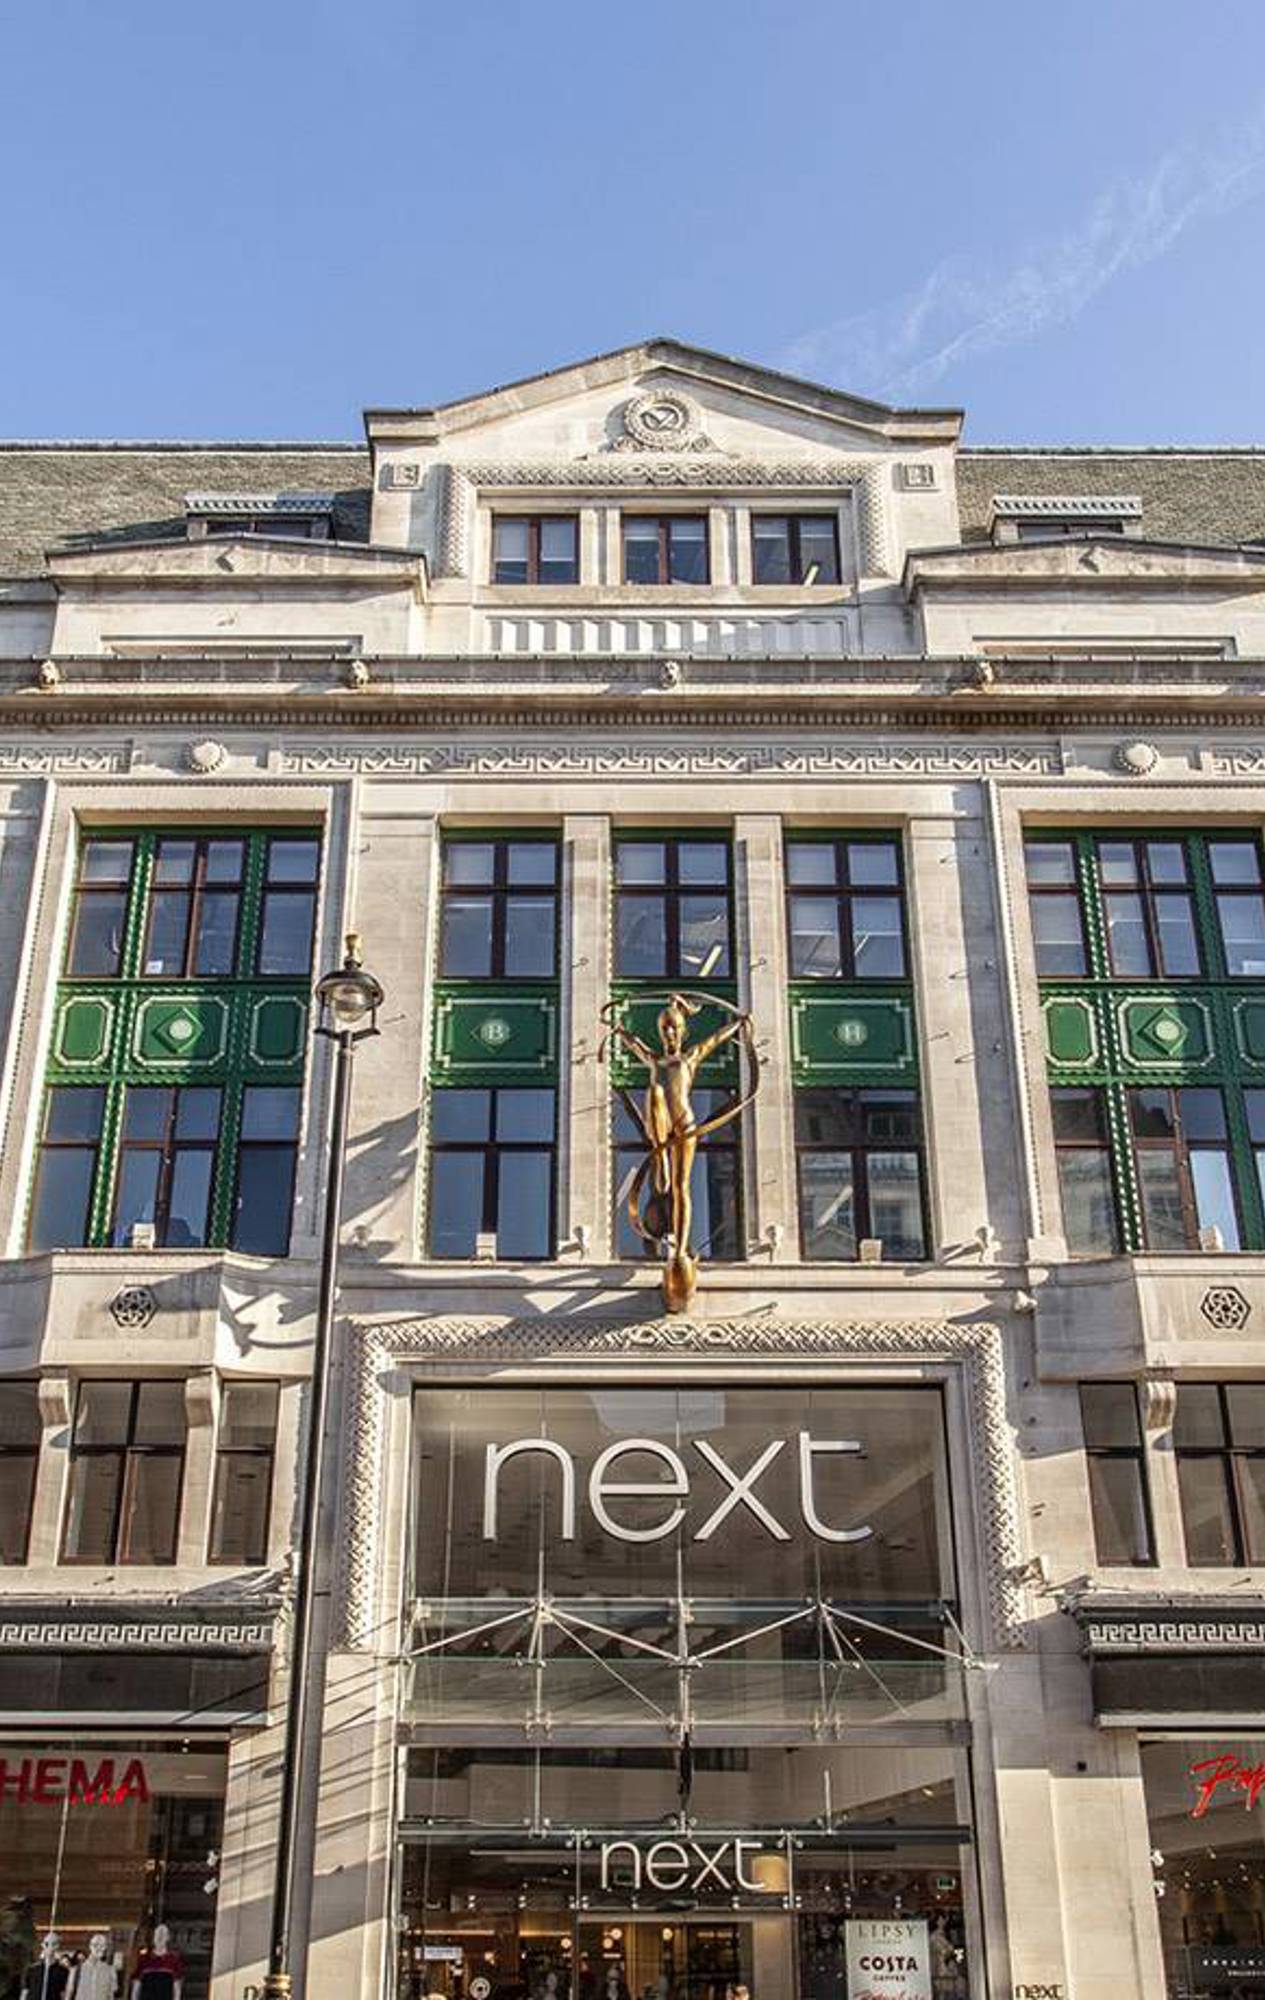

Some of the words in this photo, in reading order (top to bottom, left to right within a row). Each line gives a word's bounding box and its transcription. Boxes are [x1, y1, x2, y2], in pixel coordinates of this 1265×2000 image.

[483, 1430, 873, 1543] next
[0, 1757, 149, 1804] HEMA
[601, 1838, 766, 1890] next
[859, 1924, 915, 1938] LIPSY
[859, 1955, 919, 1973] COSTA
[1015, 1984, 1063, 1999] next
